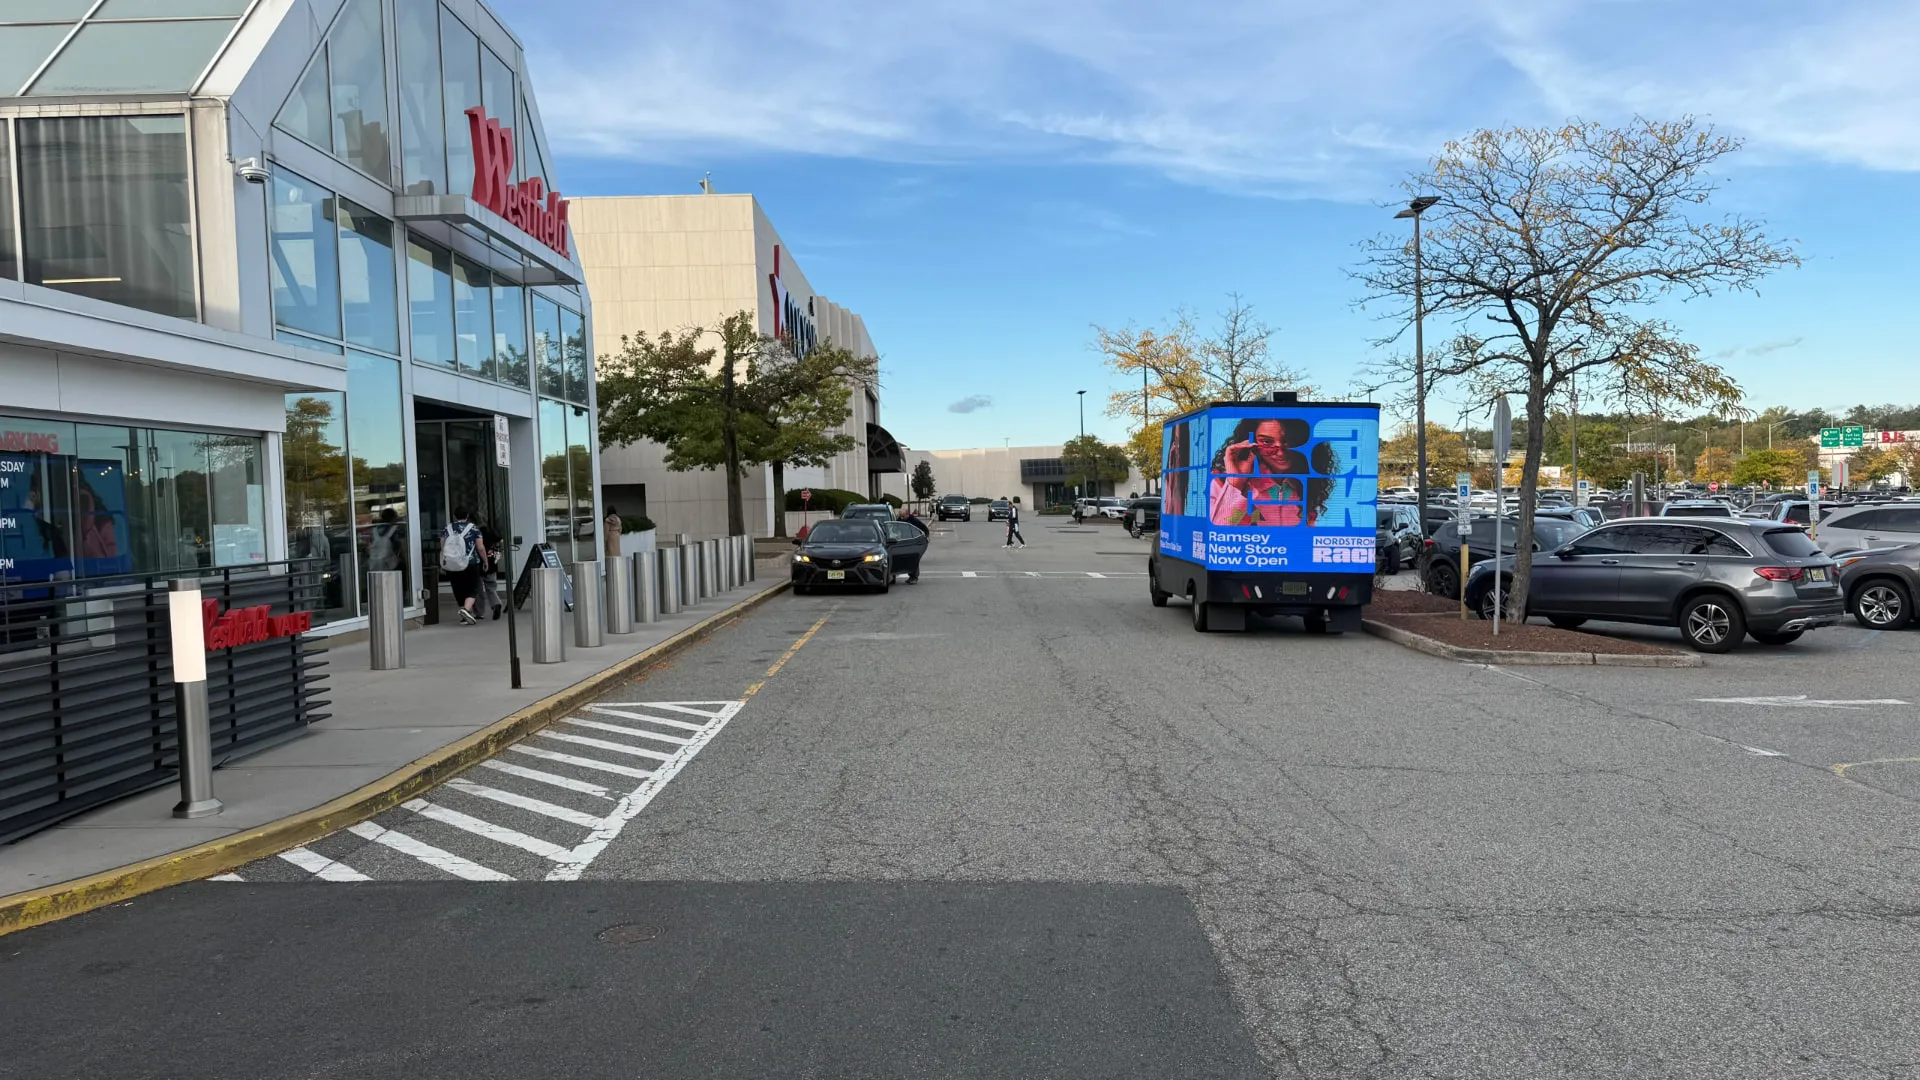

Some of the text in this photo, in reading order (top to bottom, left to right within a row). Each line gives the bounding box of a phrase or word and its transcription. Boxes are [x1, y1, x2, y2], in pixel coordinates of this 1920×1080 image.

[464, 106, 570, 260] Westfield
[0, 461, 25, 473] SDAY
[0, 517, 16, 529] PM
[1208, 531, 1271, 545] Ramsey
[1208, 543, 1287, 555] New Store
[1208, 554, 1288, 568] Now Open
[269, 611, 313, 638] VALET
